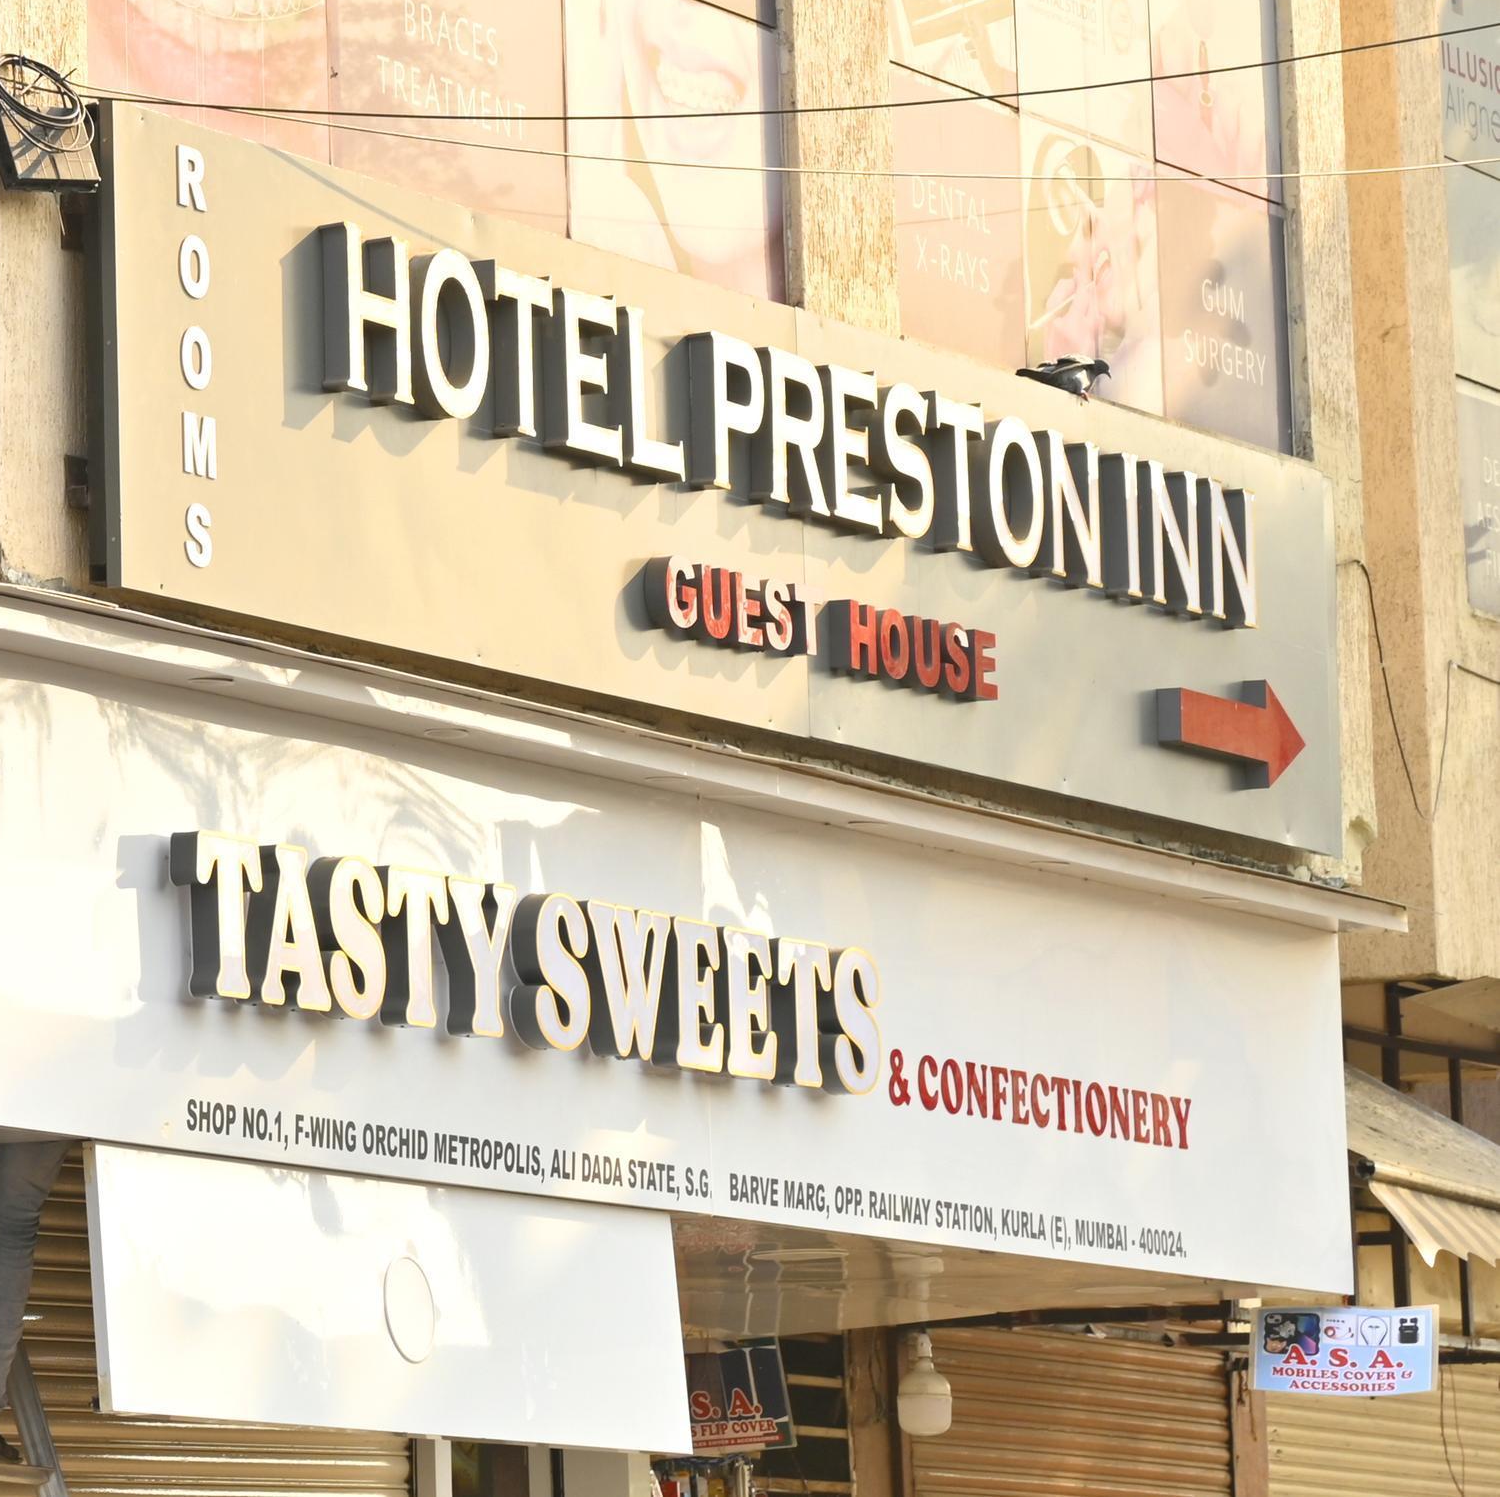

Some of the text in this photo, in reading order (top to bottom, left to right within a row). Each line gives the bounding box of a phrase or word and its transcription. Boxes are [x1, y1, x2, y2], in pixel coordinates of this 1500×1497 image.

[377, 55, 527, 141] TREATMENT
[915, 231, 990, 294] X-RAYS
[1200, 278, 1246, 325] GUM
[176, 144, 216, 568] ROOMS
[1183, 328, 1267, 388] SURGERY
[337, 221, 1258, 630] HOTEL PRESTON INN
[666, 556, 998, 701] GUEST HOUSE
[199, 829, 1192, 1150] TASTY SWEETS & CONFECTIONERY
[186, 1097, 780, 1208] SHOP NO.1, F-WING ORCHID METROPOLIS, BARVE
[1272, 1367, 1396, 1380] MOBILES COVER
[1290, 1380, 1395, 1391] ACCESSORIES
[701, 1420, 777, 1437] FLIP COVER
